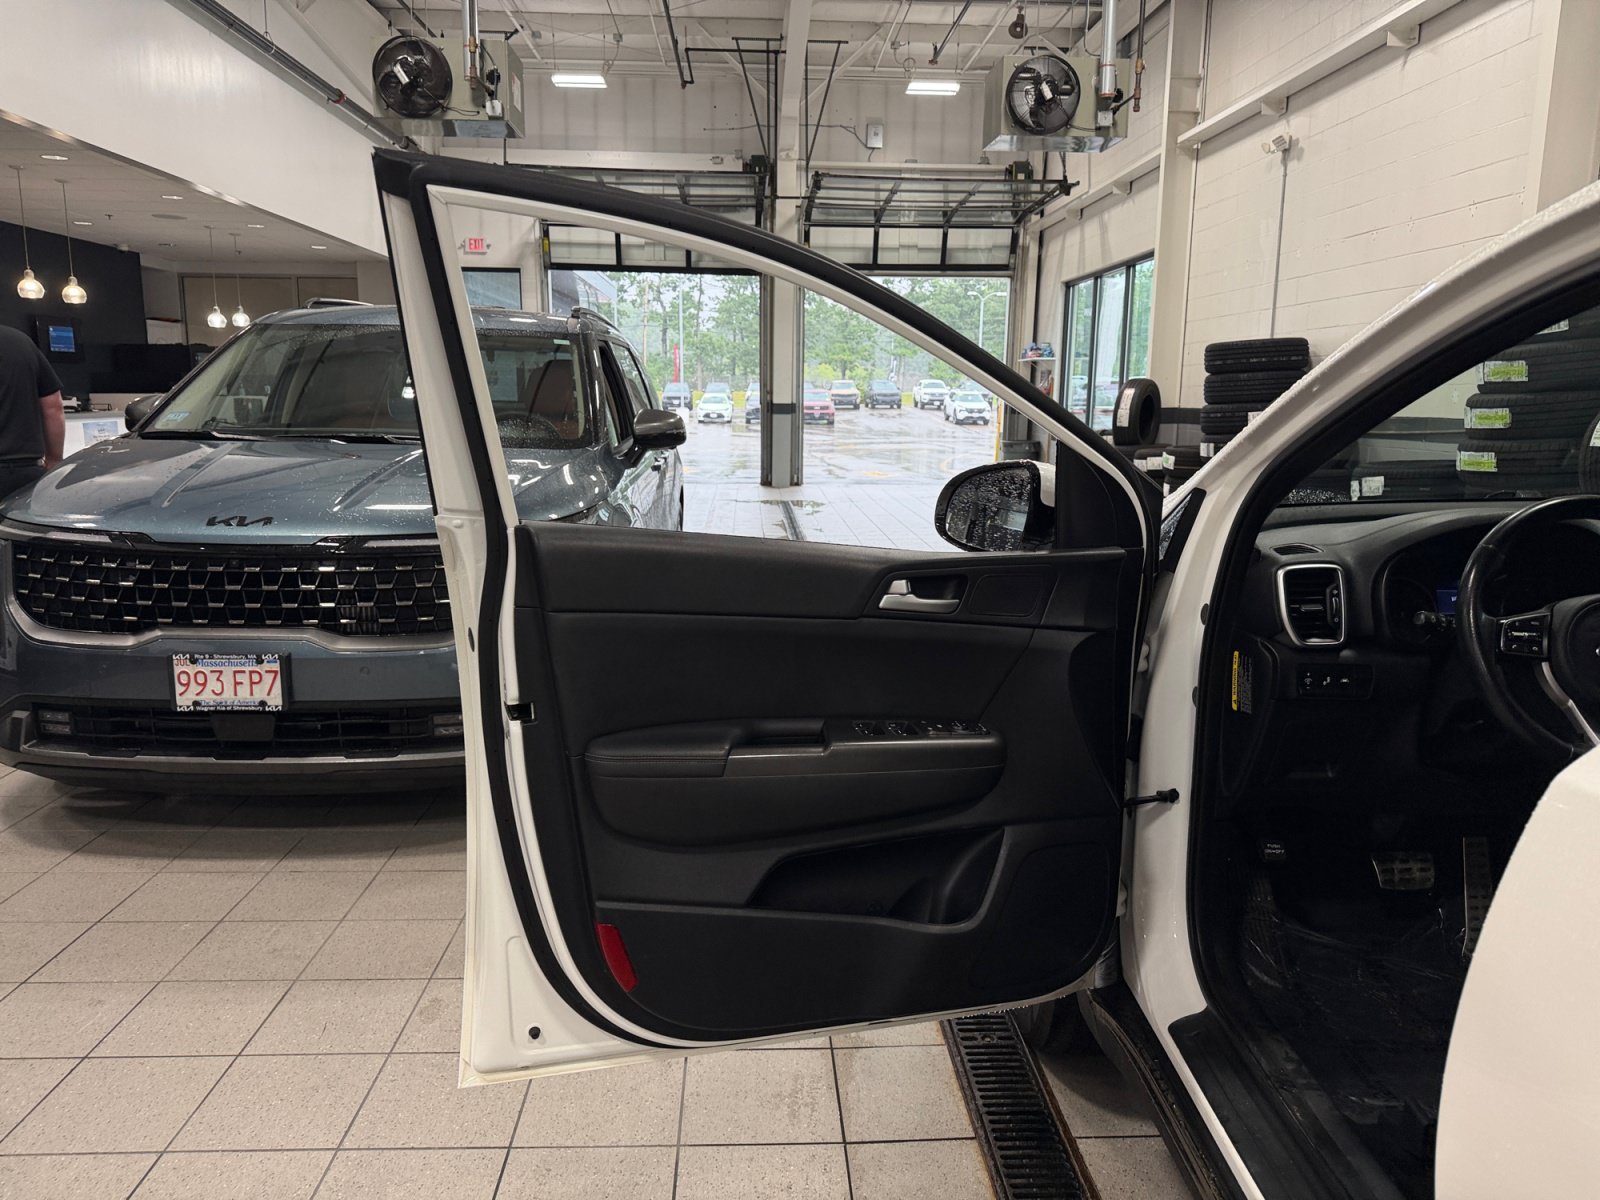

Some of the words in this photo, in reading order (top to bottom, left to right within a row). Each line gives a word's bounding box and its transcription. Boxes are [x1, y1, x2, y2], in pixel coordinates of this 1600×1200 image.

[468, 238, 484, 250] EXIT
[206, 515, 273, 527] KIA
[177, 670, 225, 697] 993
[233, 670, 279, 697] FP7
